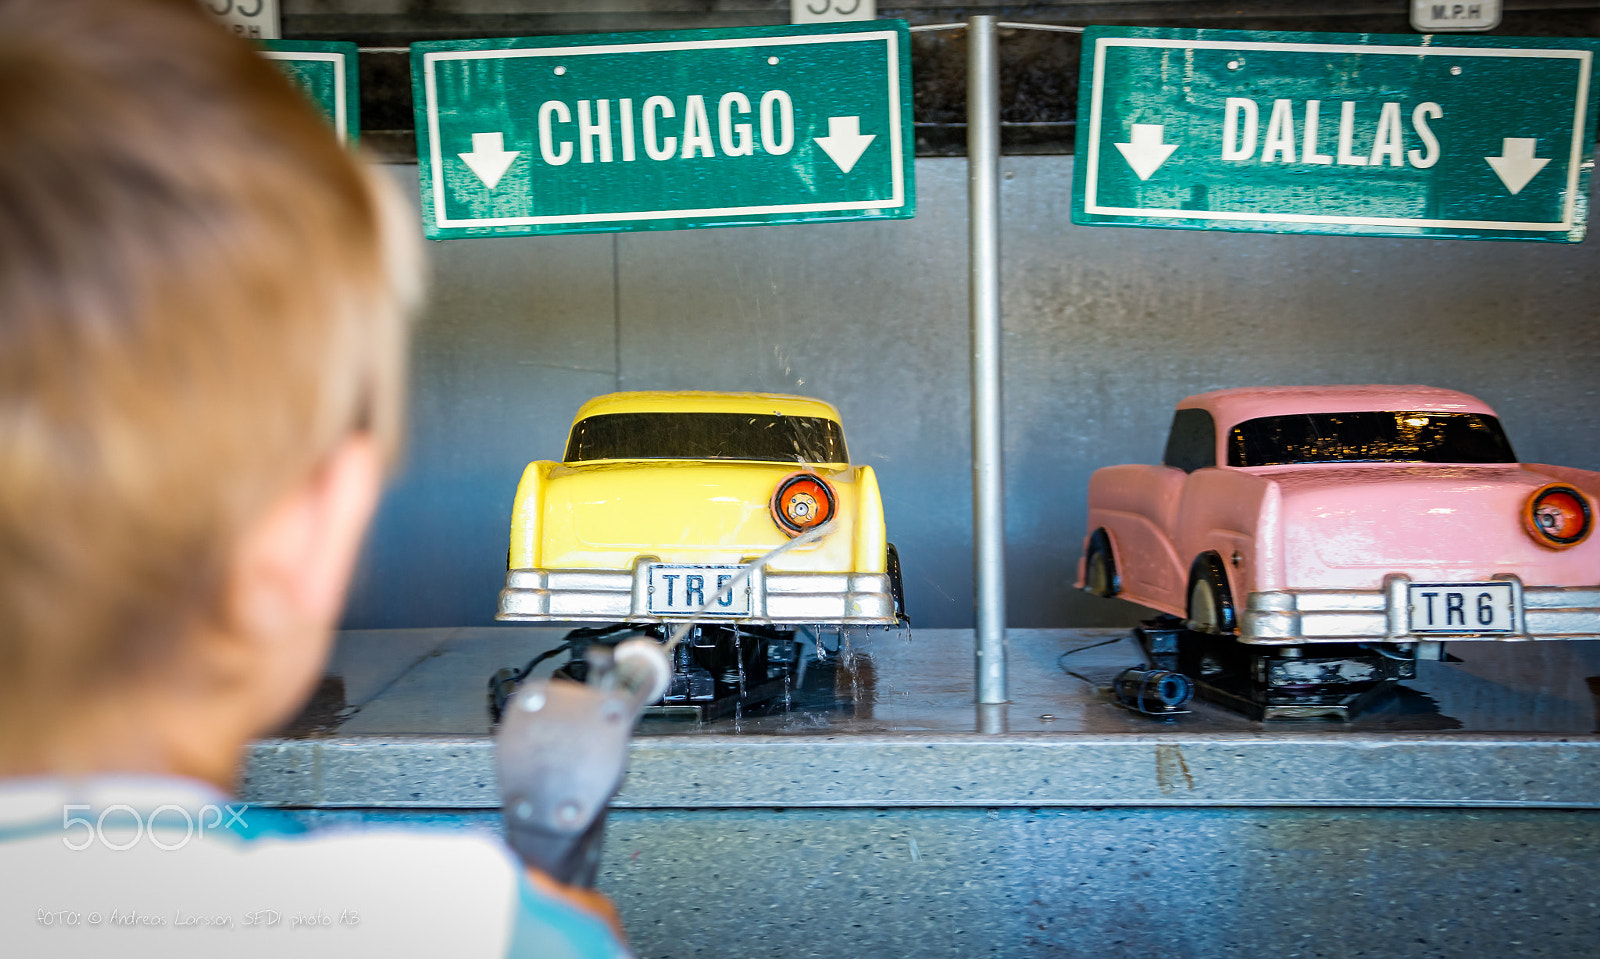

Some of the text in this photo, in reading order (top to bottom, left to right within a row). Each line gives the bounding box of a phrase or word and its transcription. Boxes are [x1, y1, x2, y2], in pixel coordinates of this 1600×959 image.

[538, 89, 795, 166] CHICAGO
[1221, 97, 1444, 169] DALLAS
[662, 574, 733, 608] TR 5
[1421, 592, 1494, 626] TR 6
